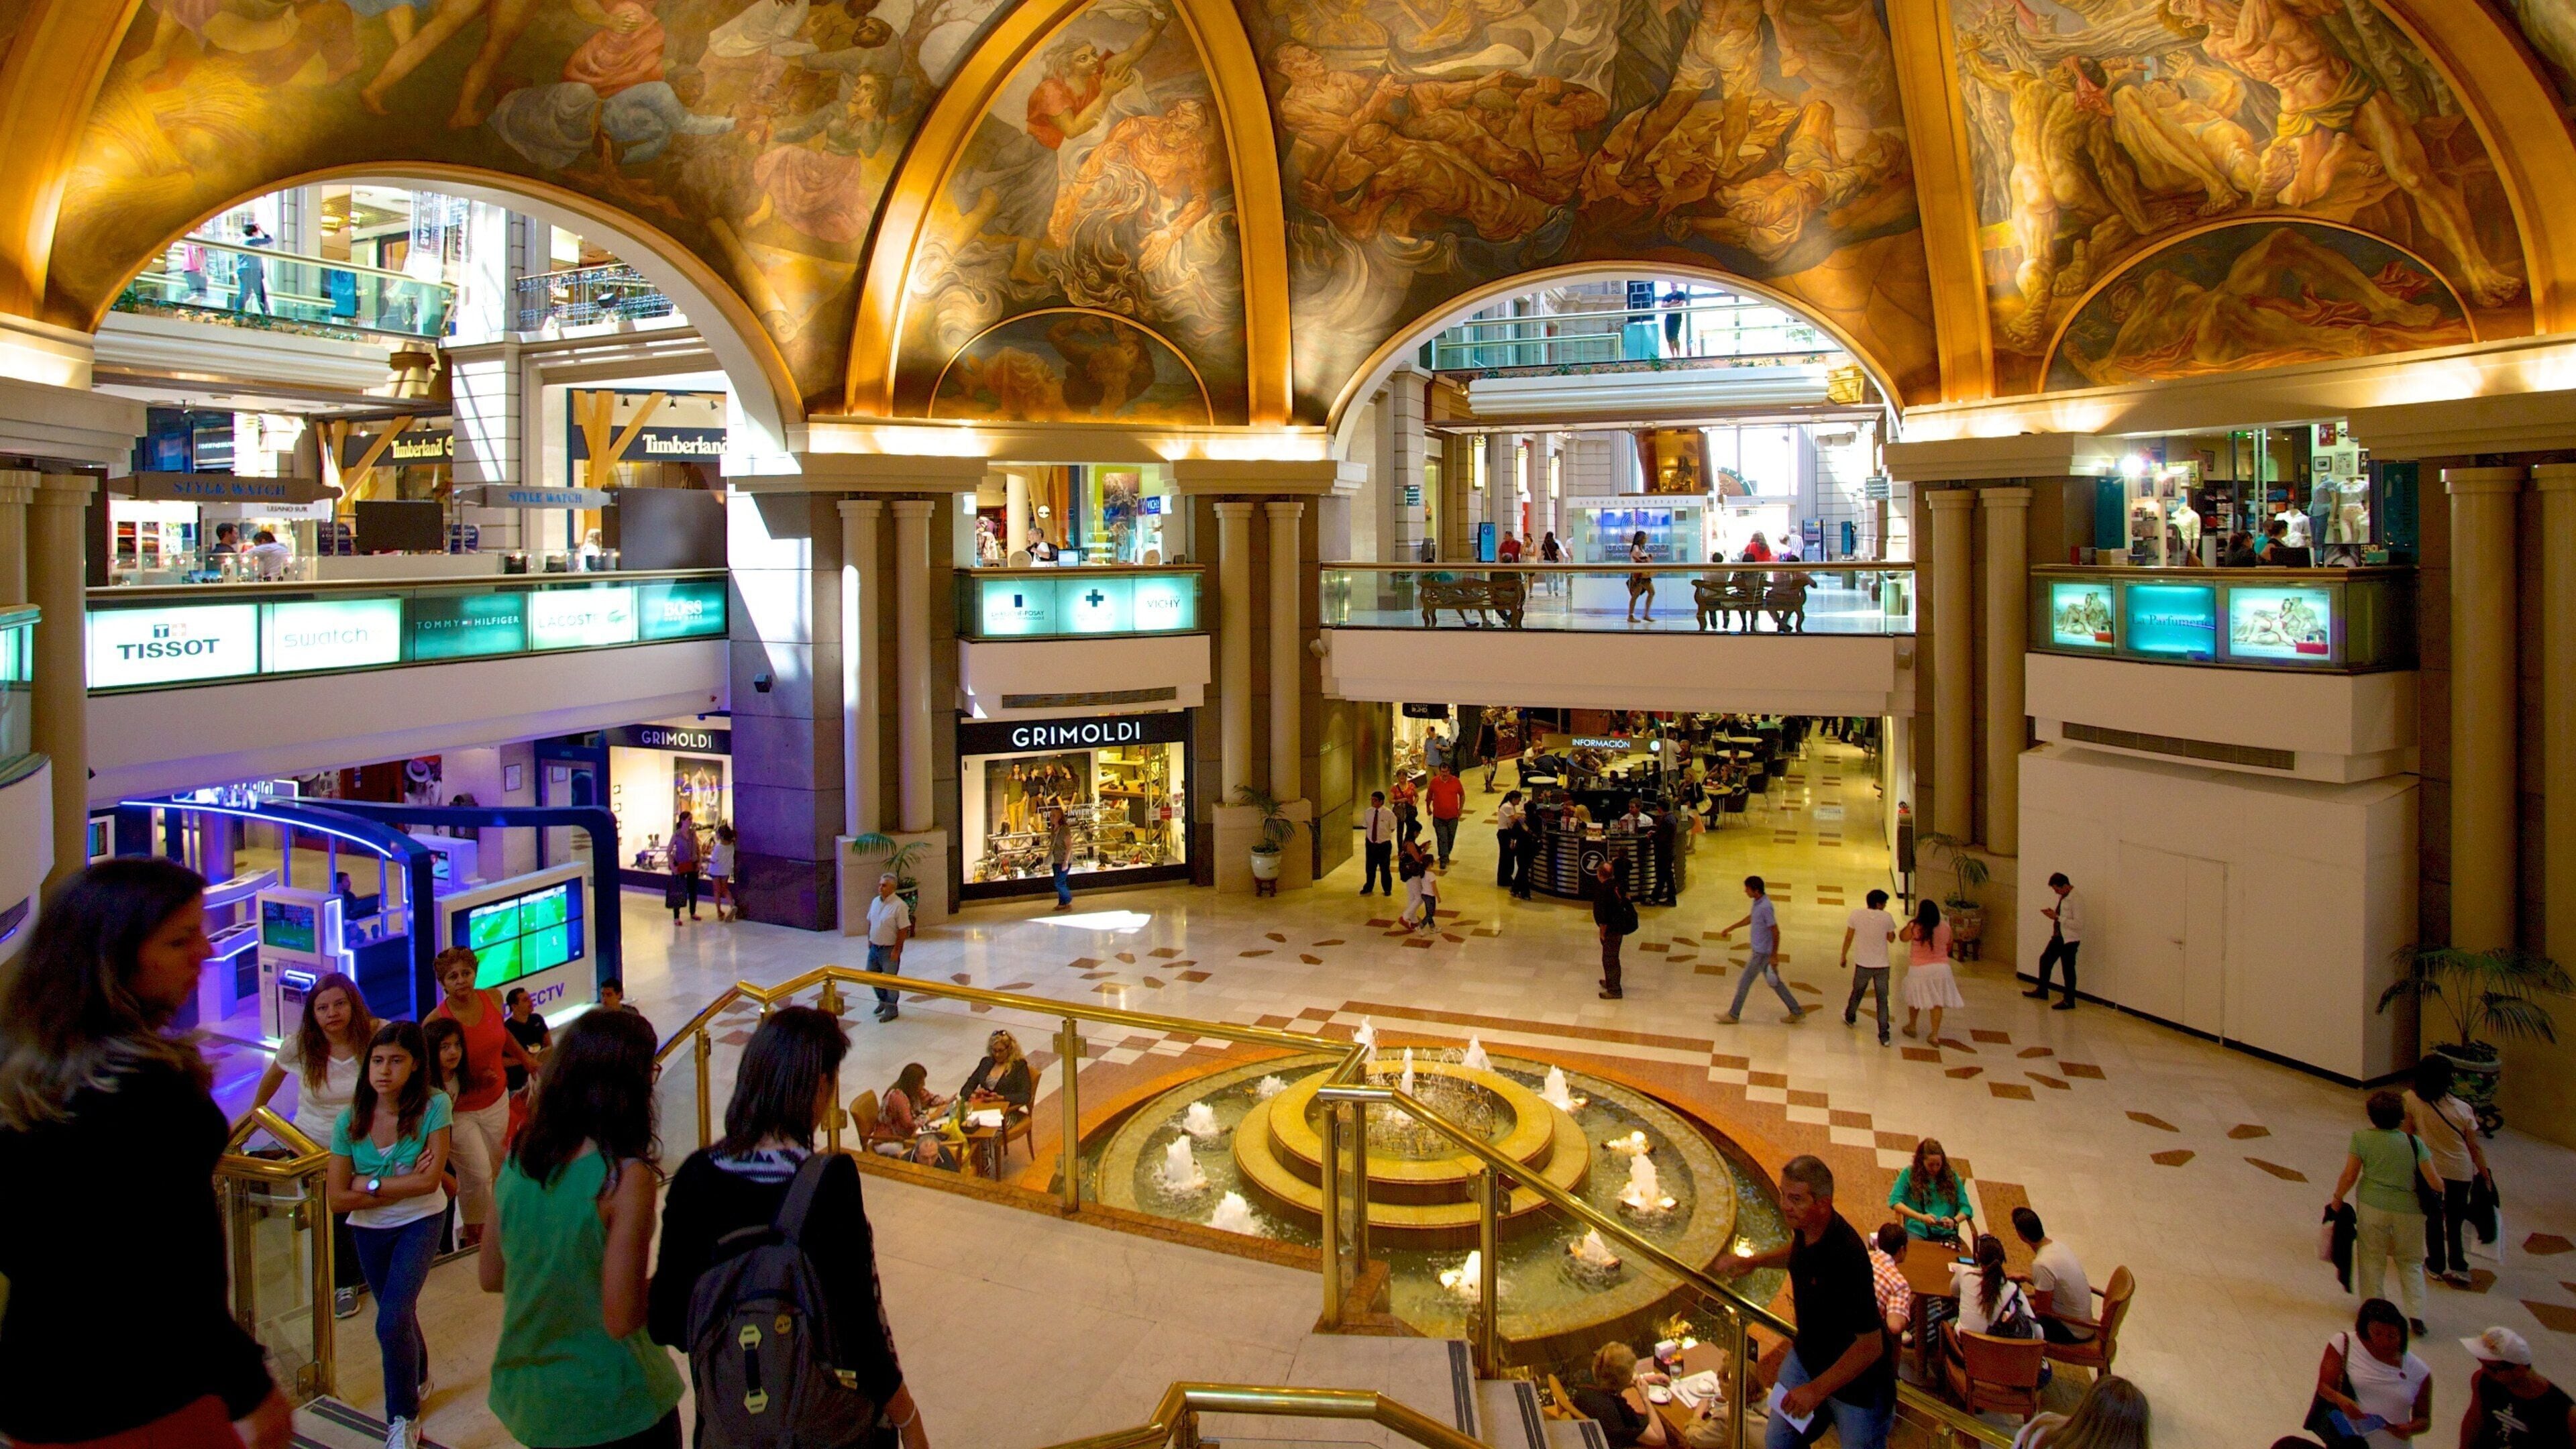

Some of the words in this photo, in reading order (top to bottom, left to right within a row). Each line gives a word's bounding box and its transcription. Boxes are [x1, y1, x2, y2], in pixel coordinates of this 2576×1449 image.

[390, 437, 443, 459] Timberland
[642, 433, 728, 455] Timberland
[173, 482, 226, 496] STYLE
[231, 484, 286, 497] WATCH
[508, 492, 543, 503] STYLE
[546, 493, 582, 504] WATCH
[2360, 544, 2379, 553] FENDI
[663, 600, 702, 615] BOSS
[1146, 598, 1180, 608] VICHY
[417, 619, 460, 630] TOMMY
[474, 615, 519, 627] HILFIGER
[2132, 614, 2145, 625] La
[2149, 614, 2211, 627] Parfumerie
[284, 628, 368, 648] swatch
[117, 638, 220, 660] TISSOT
[641, 730, 712, 749] GRIMOLDI
[1012, 720, 1141, 747] GRIMOLDI
[1572, 739, 1630, 749] INFORMACIÓN
[502, 982, 565, 1018] DECTV
